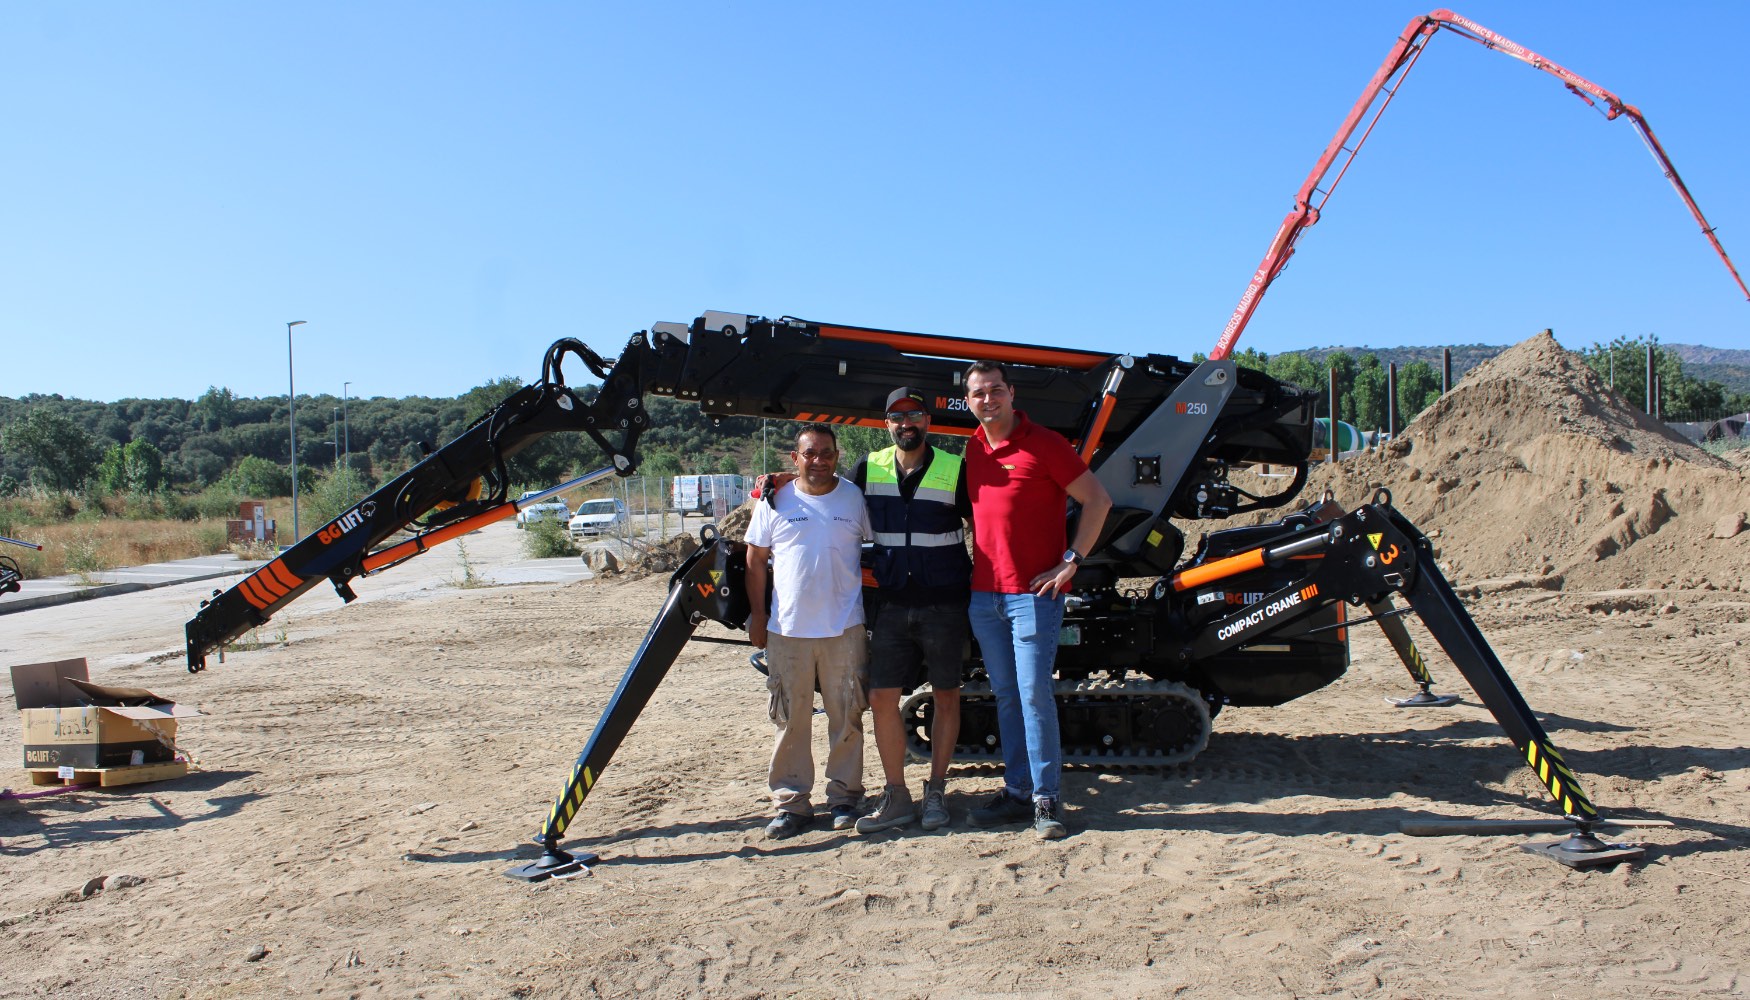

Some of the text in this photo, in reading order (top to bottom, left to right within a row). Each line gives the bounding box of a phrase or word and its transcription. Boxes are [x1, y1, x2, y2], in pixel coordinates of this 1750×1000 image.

[1217, 312, 1242, 350] BOMBEOS
[1176, 402, 1208, 415] M250
[1380, 544, 1399, 565] 3
[697, 583, 715, 598] 4
[1217, 591, 1302, 641] COMPACT CRANE
